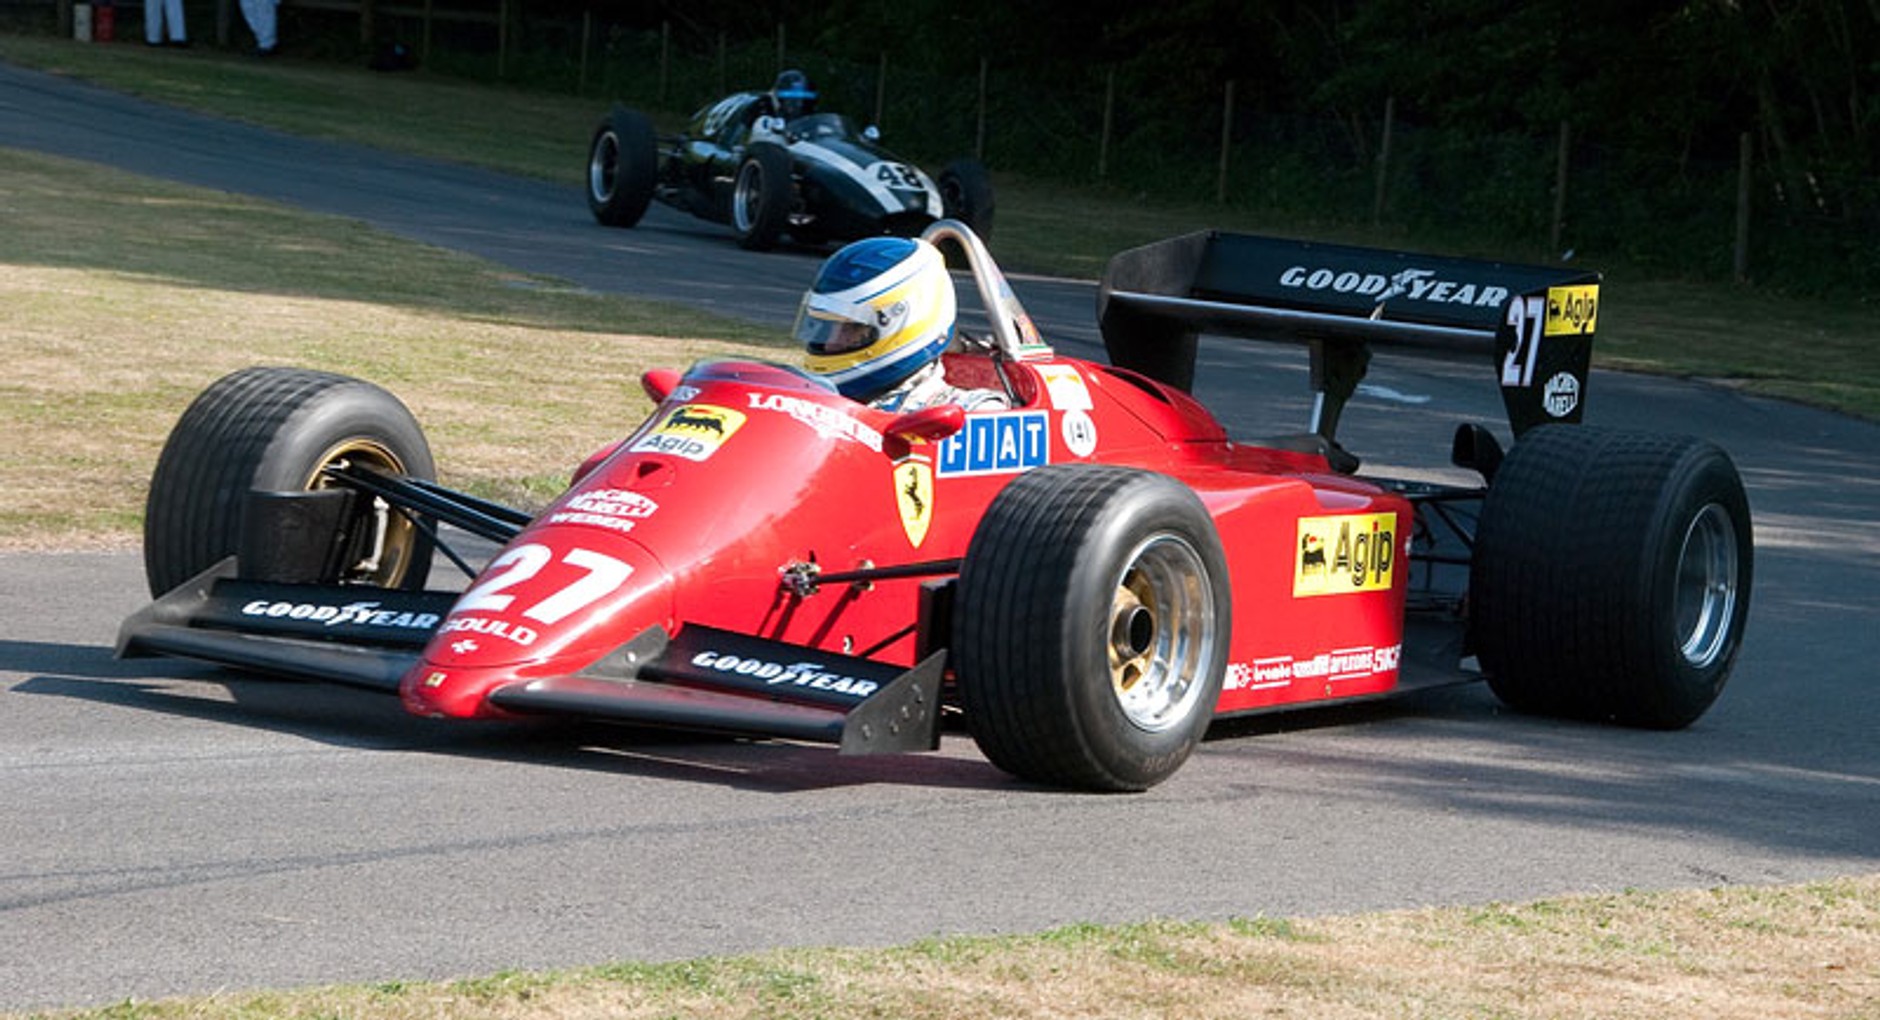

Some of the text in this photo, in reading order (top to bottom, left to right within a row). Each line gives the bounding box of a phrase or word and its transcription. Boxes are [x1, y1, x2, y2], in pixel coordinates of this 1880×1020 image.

[877, 163, 925, 190] 48
[1279, 266, 1508, 309] GOODYEAR
[1562, 291, 1595, 331] Agip
[1501, 296, 1545, 387] 27
[639, 433, 704, 456] Agip
[948, 423, 1043, 465] FIAT
[1331, 520, 1393, 586] Agip
[451, 543, 635, 625] 27
[241, 599, 440, 630] GOODYEAR
[437, 616, 538, 646] GOULD
[690, 650, 879, 697] GOODYEAR
